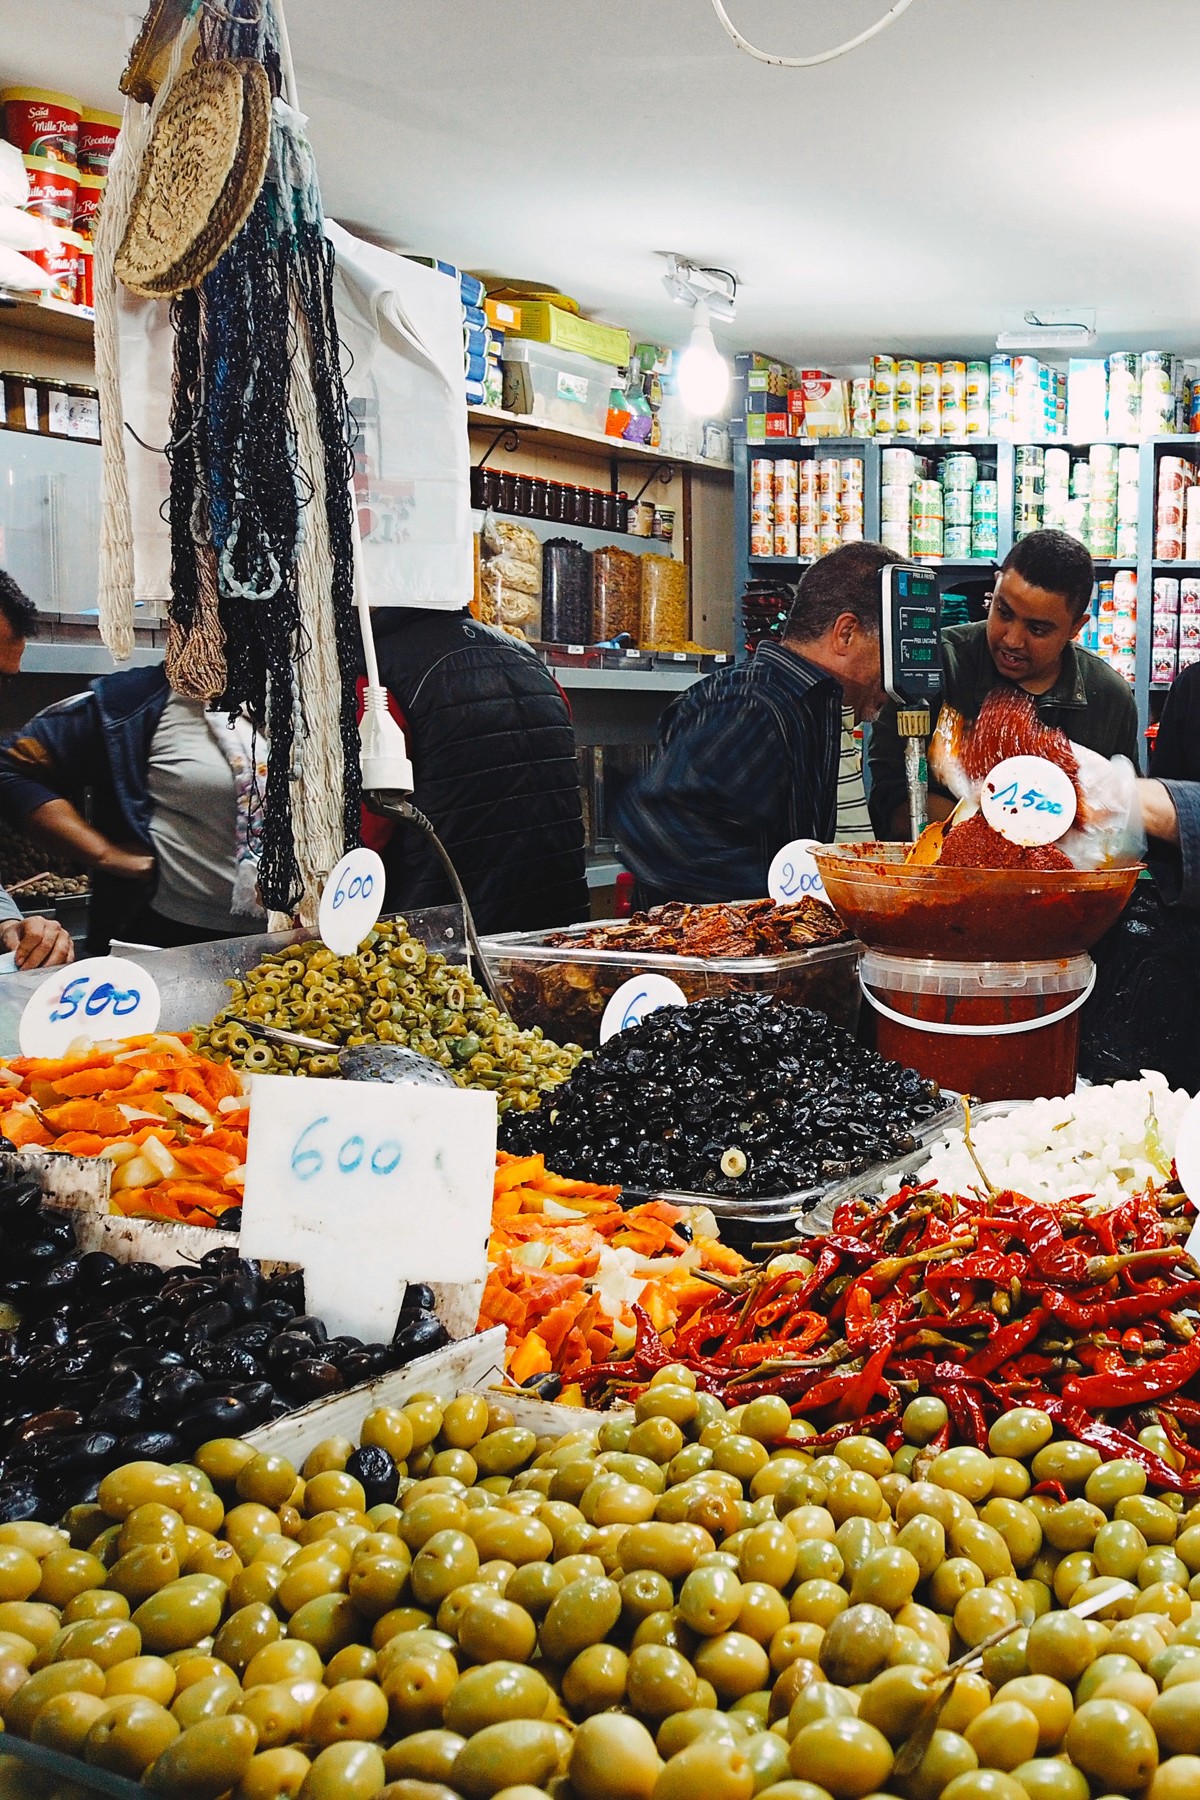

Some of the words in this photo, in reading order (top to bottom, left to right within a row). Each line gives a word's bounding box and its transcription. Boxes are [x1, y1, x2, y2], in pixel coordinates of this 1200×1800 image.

[991, 782, 1063, 815] 1500
[333, 867, 374, 909] 600
[50, 977, 141, 1023] 500
[291, 1116, 402, 1181] 600
